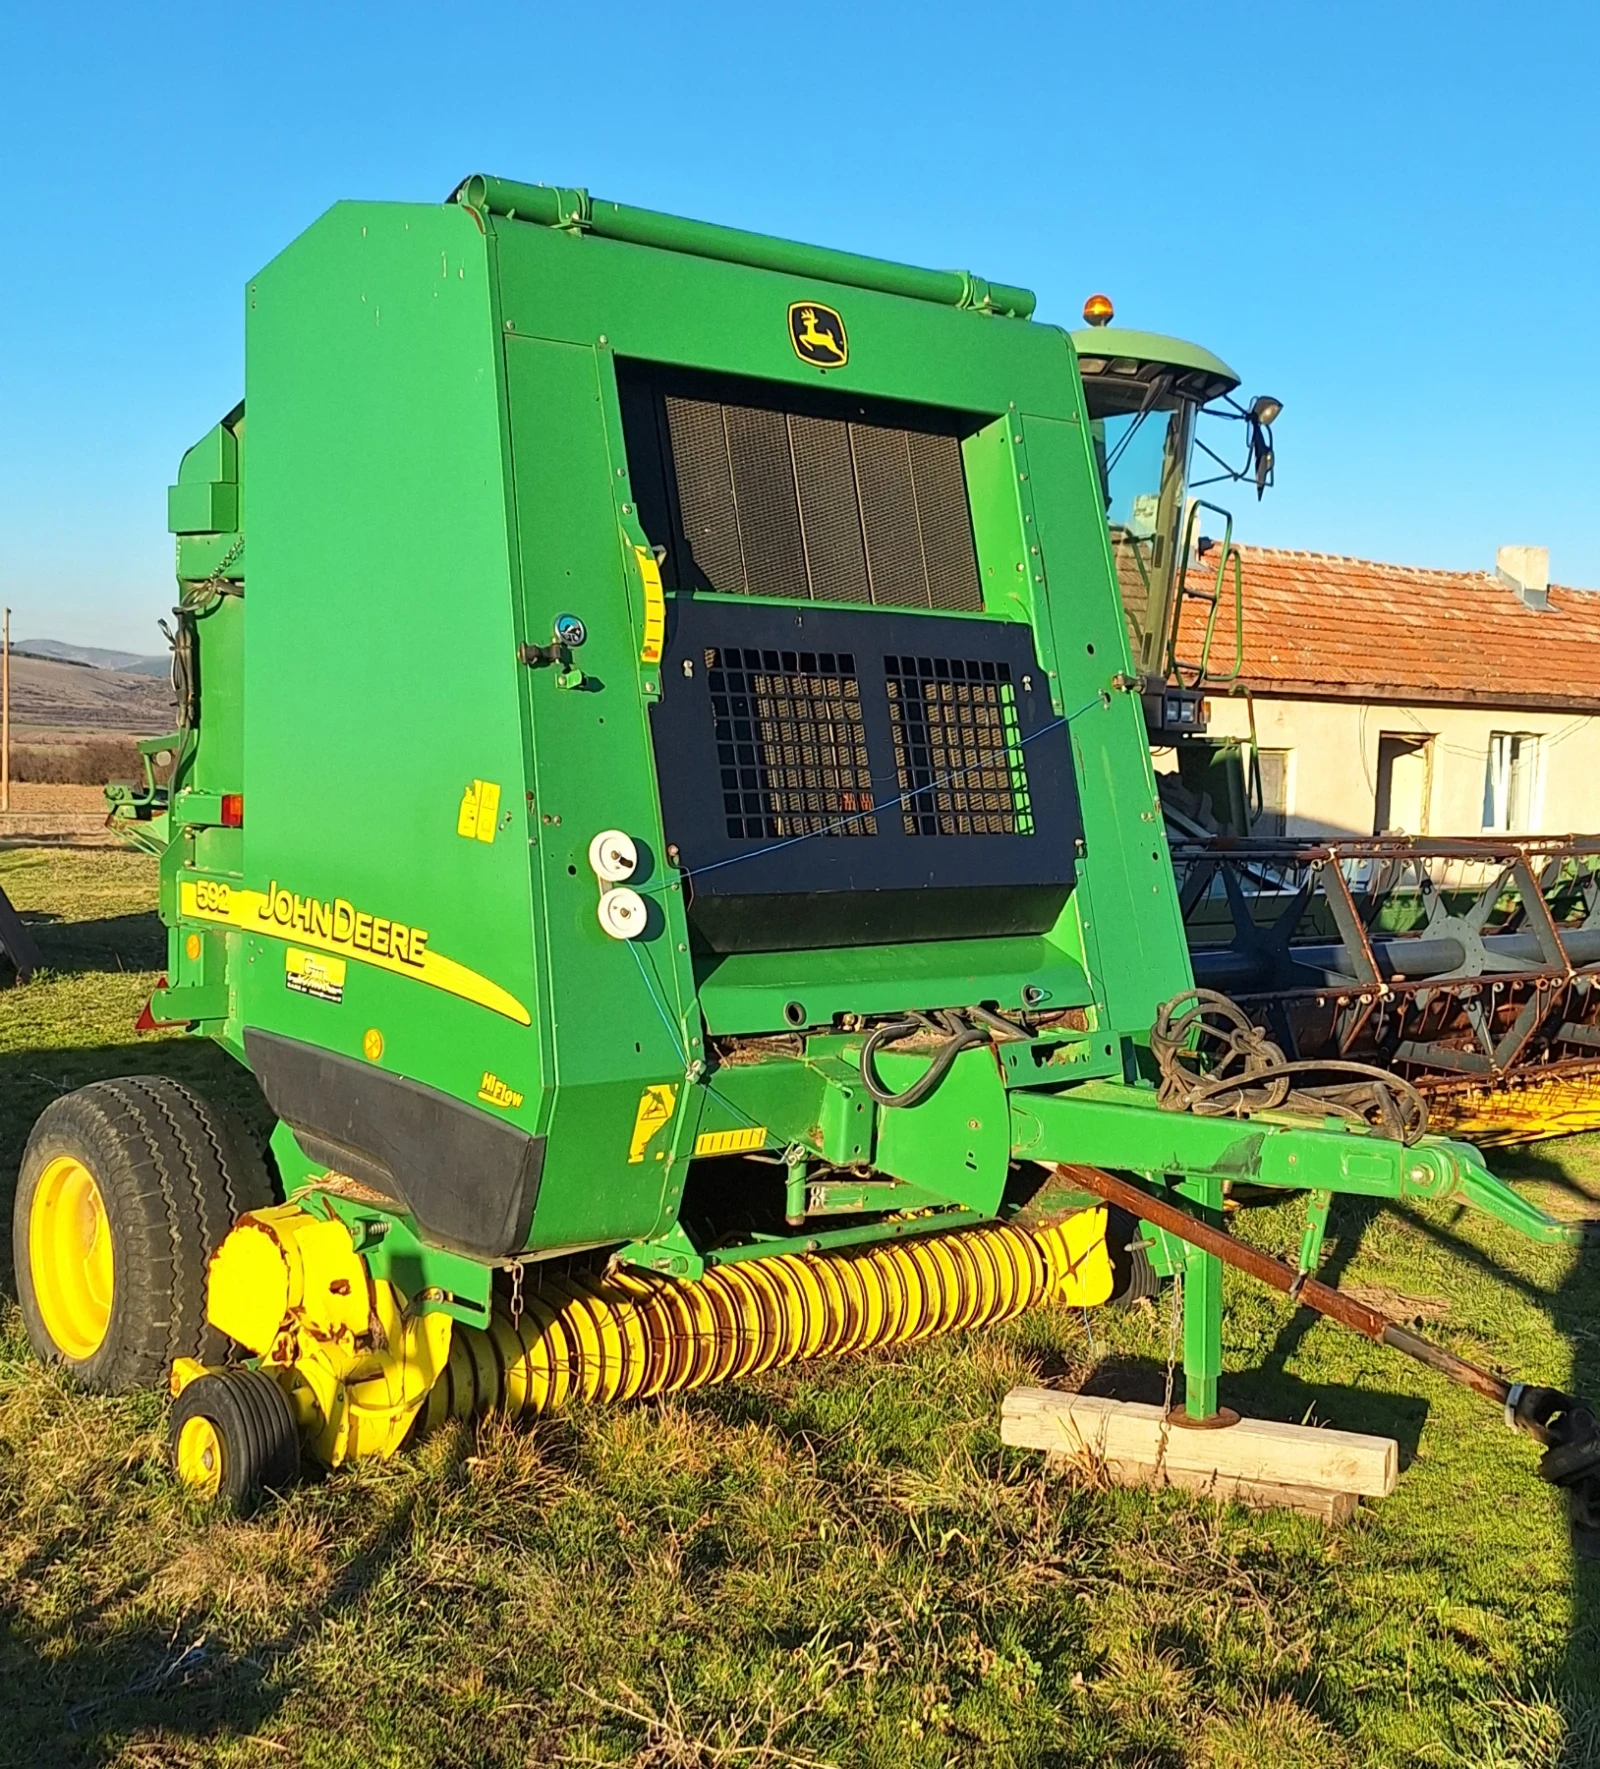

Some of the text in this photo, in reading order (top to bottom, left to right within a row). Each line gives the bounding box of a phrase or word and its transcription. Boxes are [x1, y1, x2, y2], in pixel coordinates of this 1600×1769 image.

[196, 880, 230, 914] 592
[259, 880, 428, 968] JOHN DEERE
